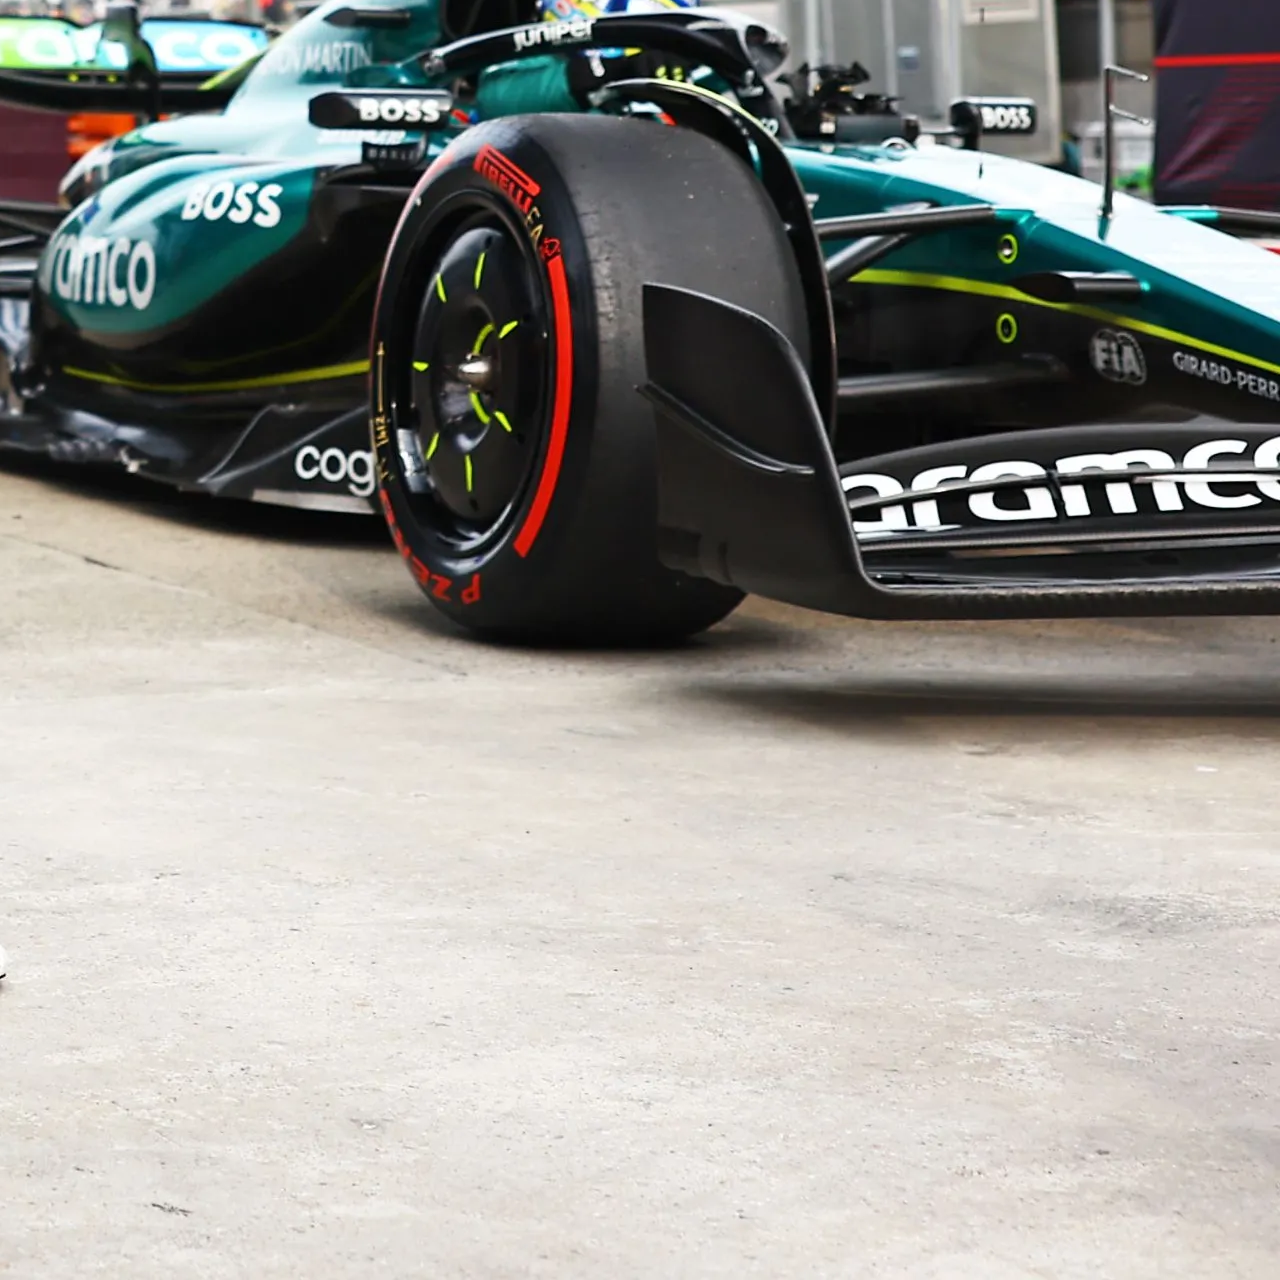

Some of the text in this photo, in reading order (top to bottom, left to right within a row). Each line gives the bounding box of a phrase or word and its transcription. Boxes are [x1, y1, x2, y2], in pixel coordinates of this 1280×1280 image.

[358, 97, 440, 124] BOSS
[981, 105, 1033, 131] BOSS
[472, 143, 542, 215] PIRELLI
[181, 181, 283, 228] BOSS
